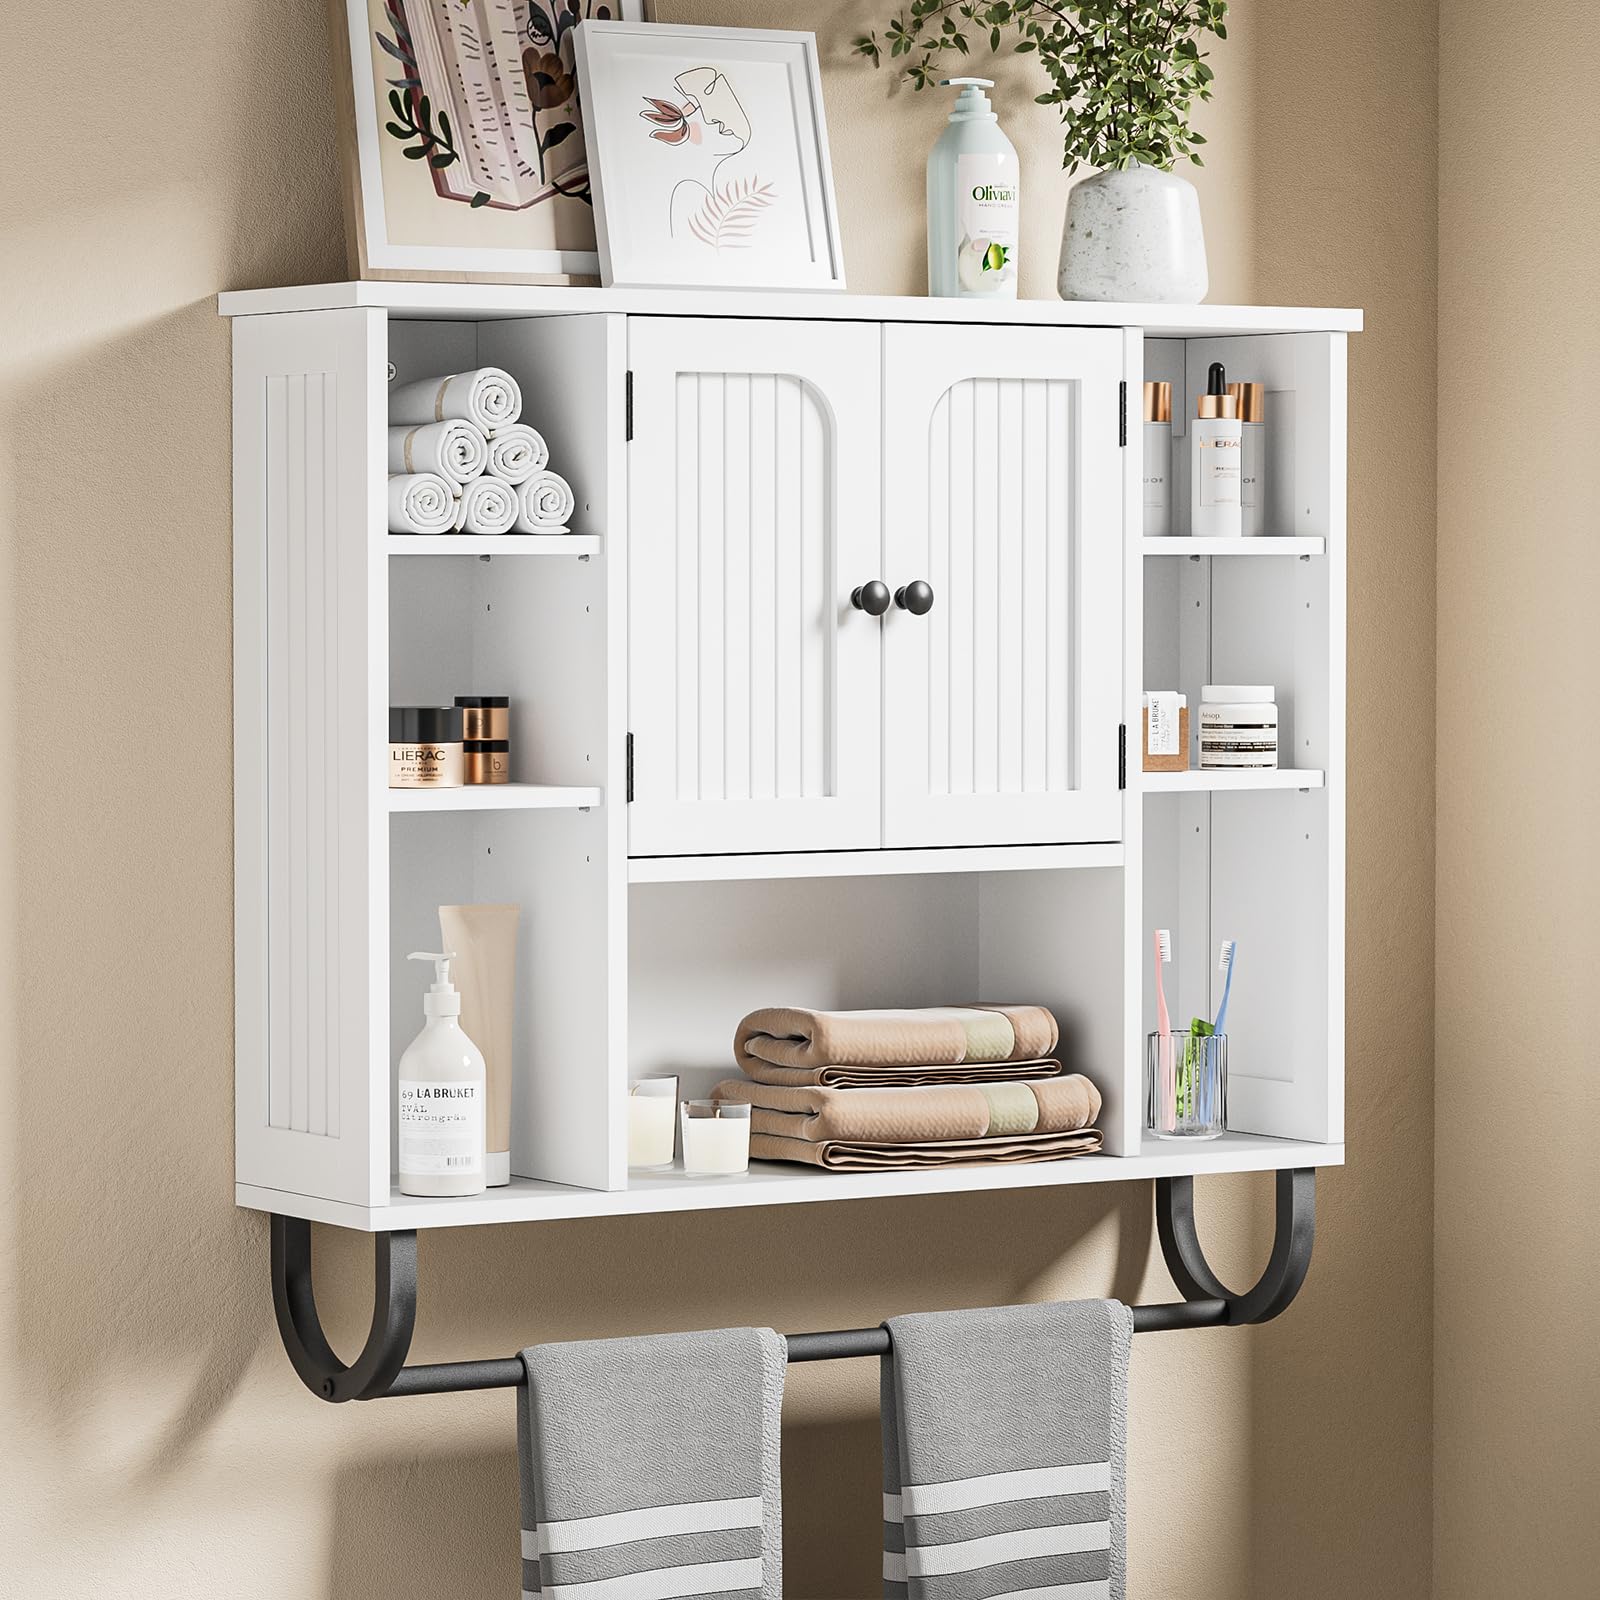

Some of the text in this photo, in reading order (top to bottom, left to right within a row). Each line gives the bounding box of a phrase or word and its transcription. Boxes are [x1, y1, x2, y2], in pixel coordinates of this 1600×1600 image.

[393, 750, 446, 761] LIERAC
[402, 1089, 413, 1100] 69
[434, 1088, 475, 1098] BRUKET
